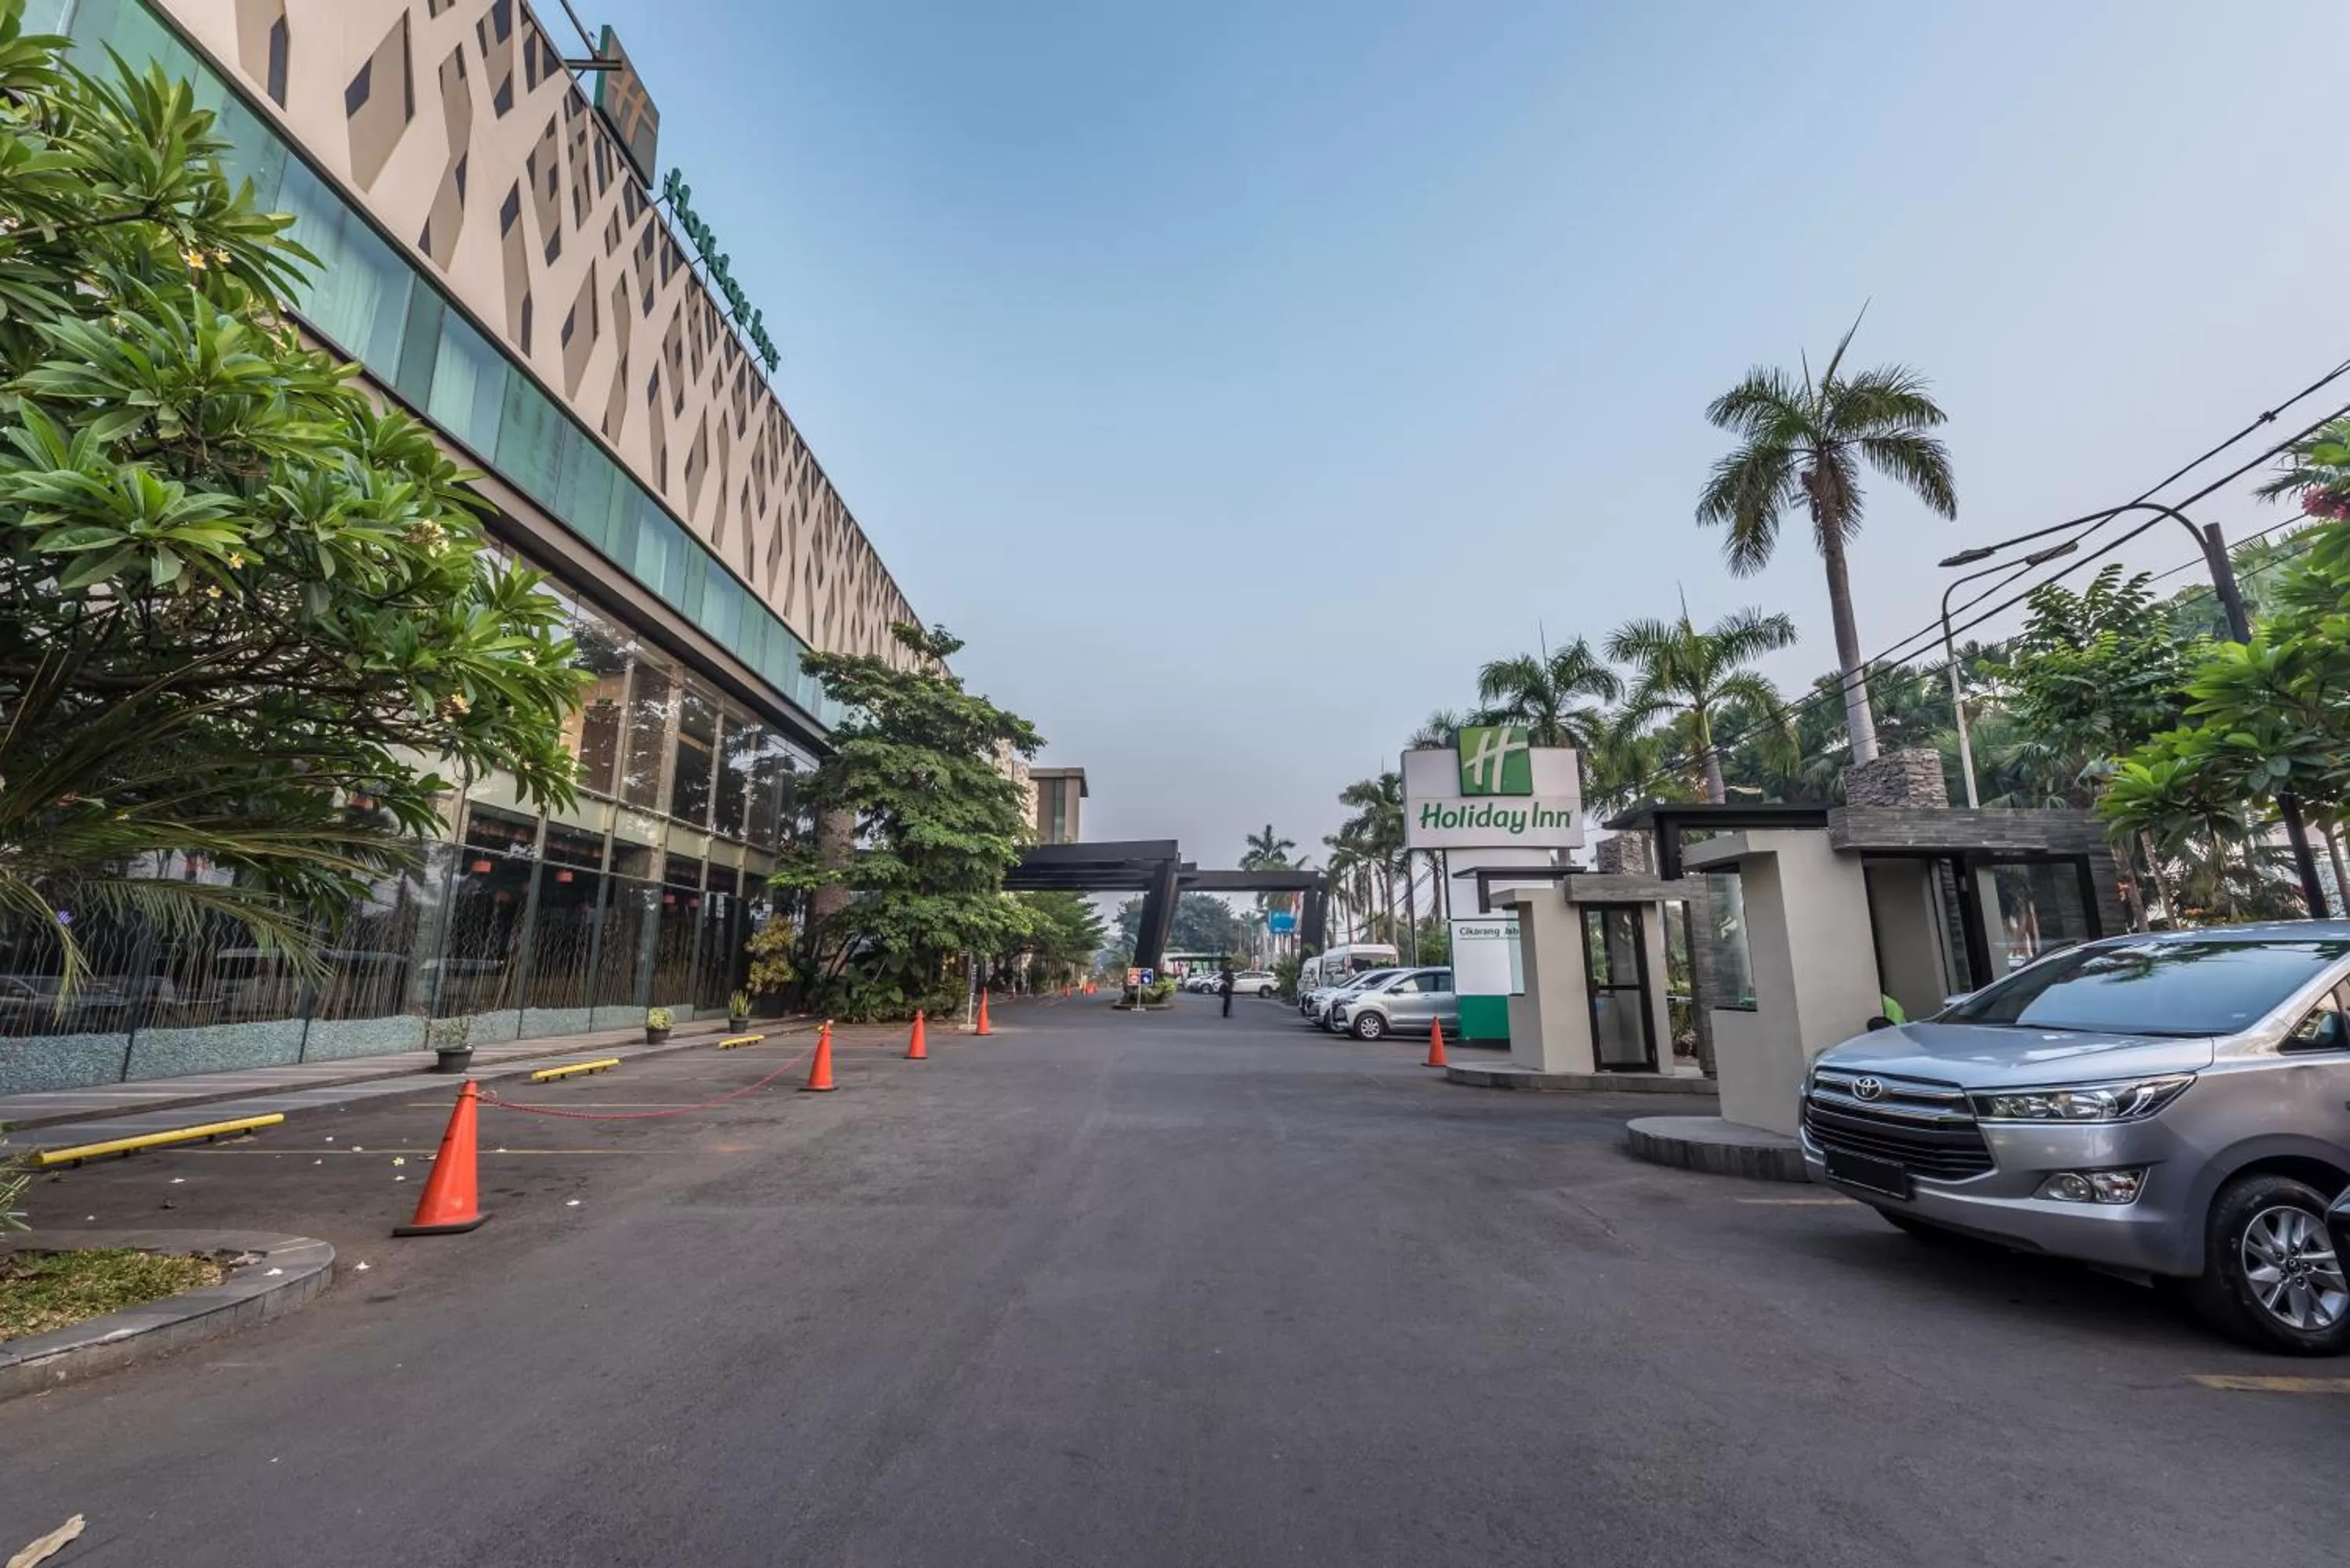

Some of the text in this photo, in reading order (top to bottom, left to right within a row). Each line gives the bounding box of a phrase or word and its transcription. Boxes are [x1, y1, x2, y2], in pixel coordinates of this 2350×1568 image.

[1419, 801, 1571, 834] Holiday Inn
[1459, 927, 1500, 937] Cikarang
